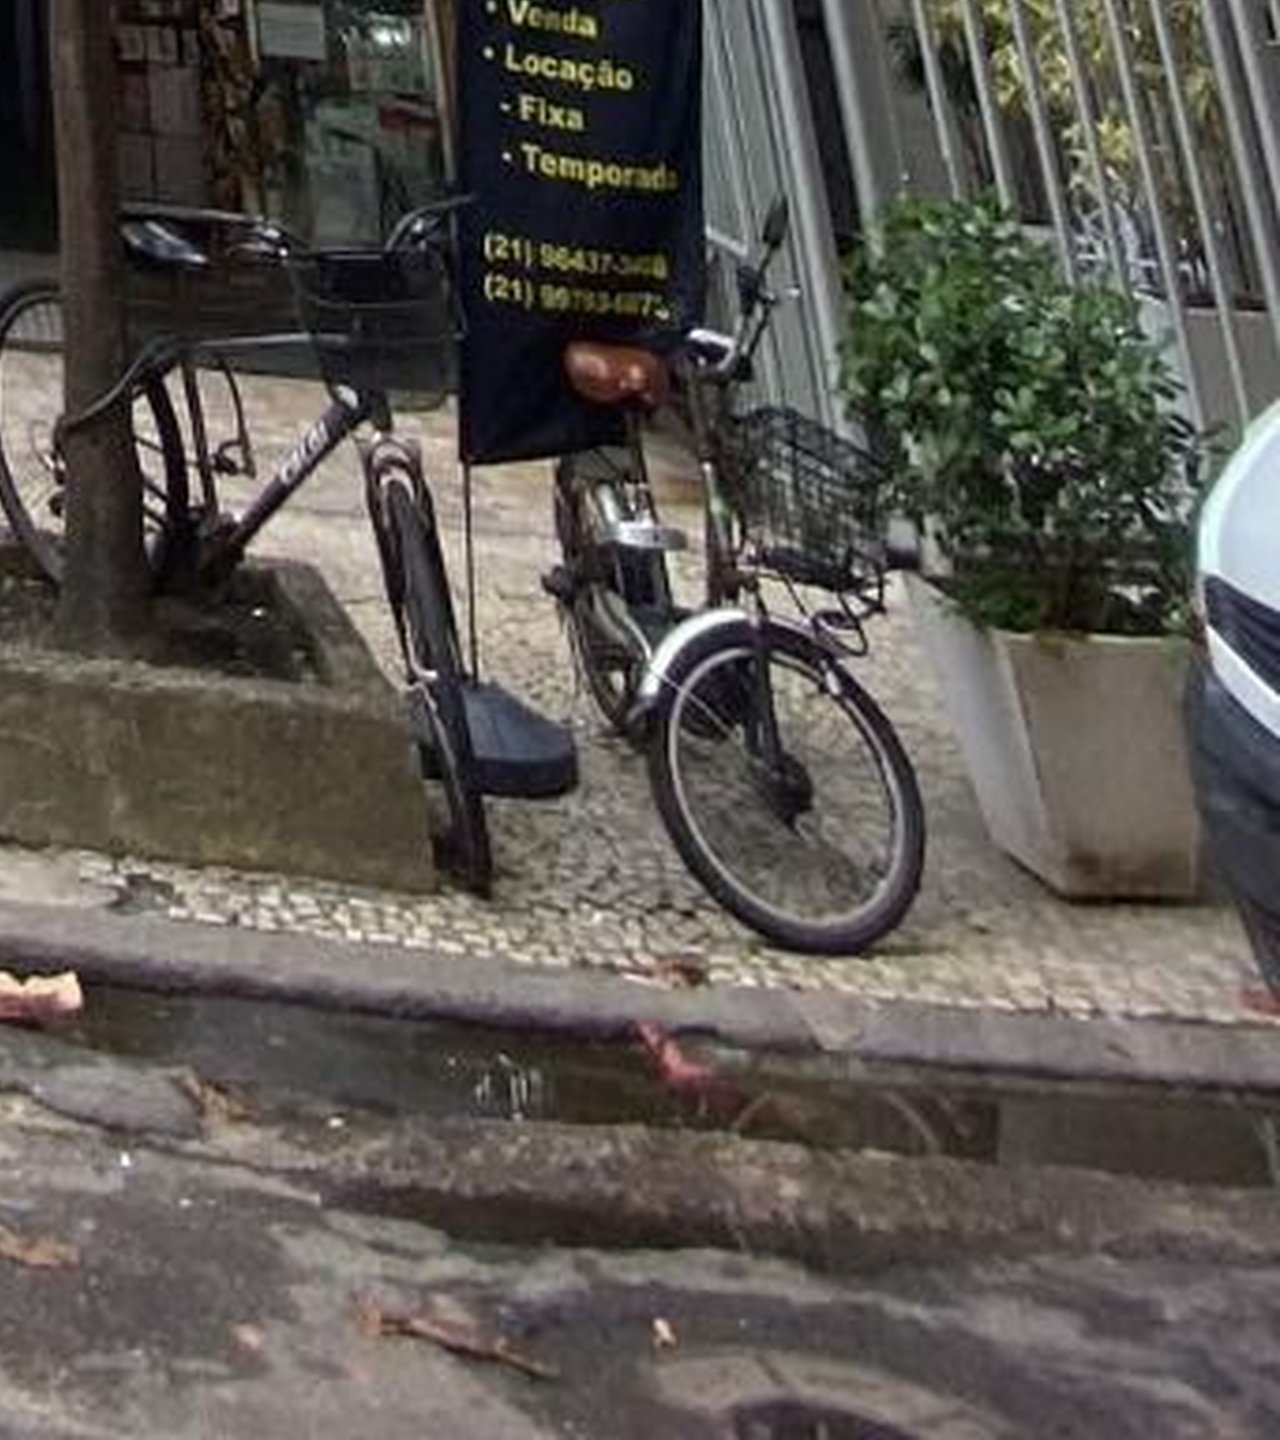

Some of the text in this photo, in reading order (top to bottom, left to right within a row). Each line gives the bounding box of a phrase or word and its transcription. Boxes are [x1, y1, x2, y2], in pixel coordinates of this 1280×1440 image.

[505, 43, 634, 91] Locação
[519, 93, 584, 130] Fixa
[484, 233, 533, 268] (21)
[484, 271, 533, 311] (21)
